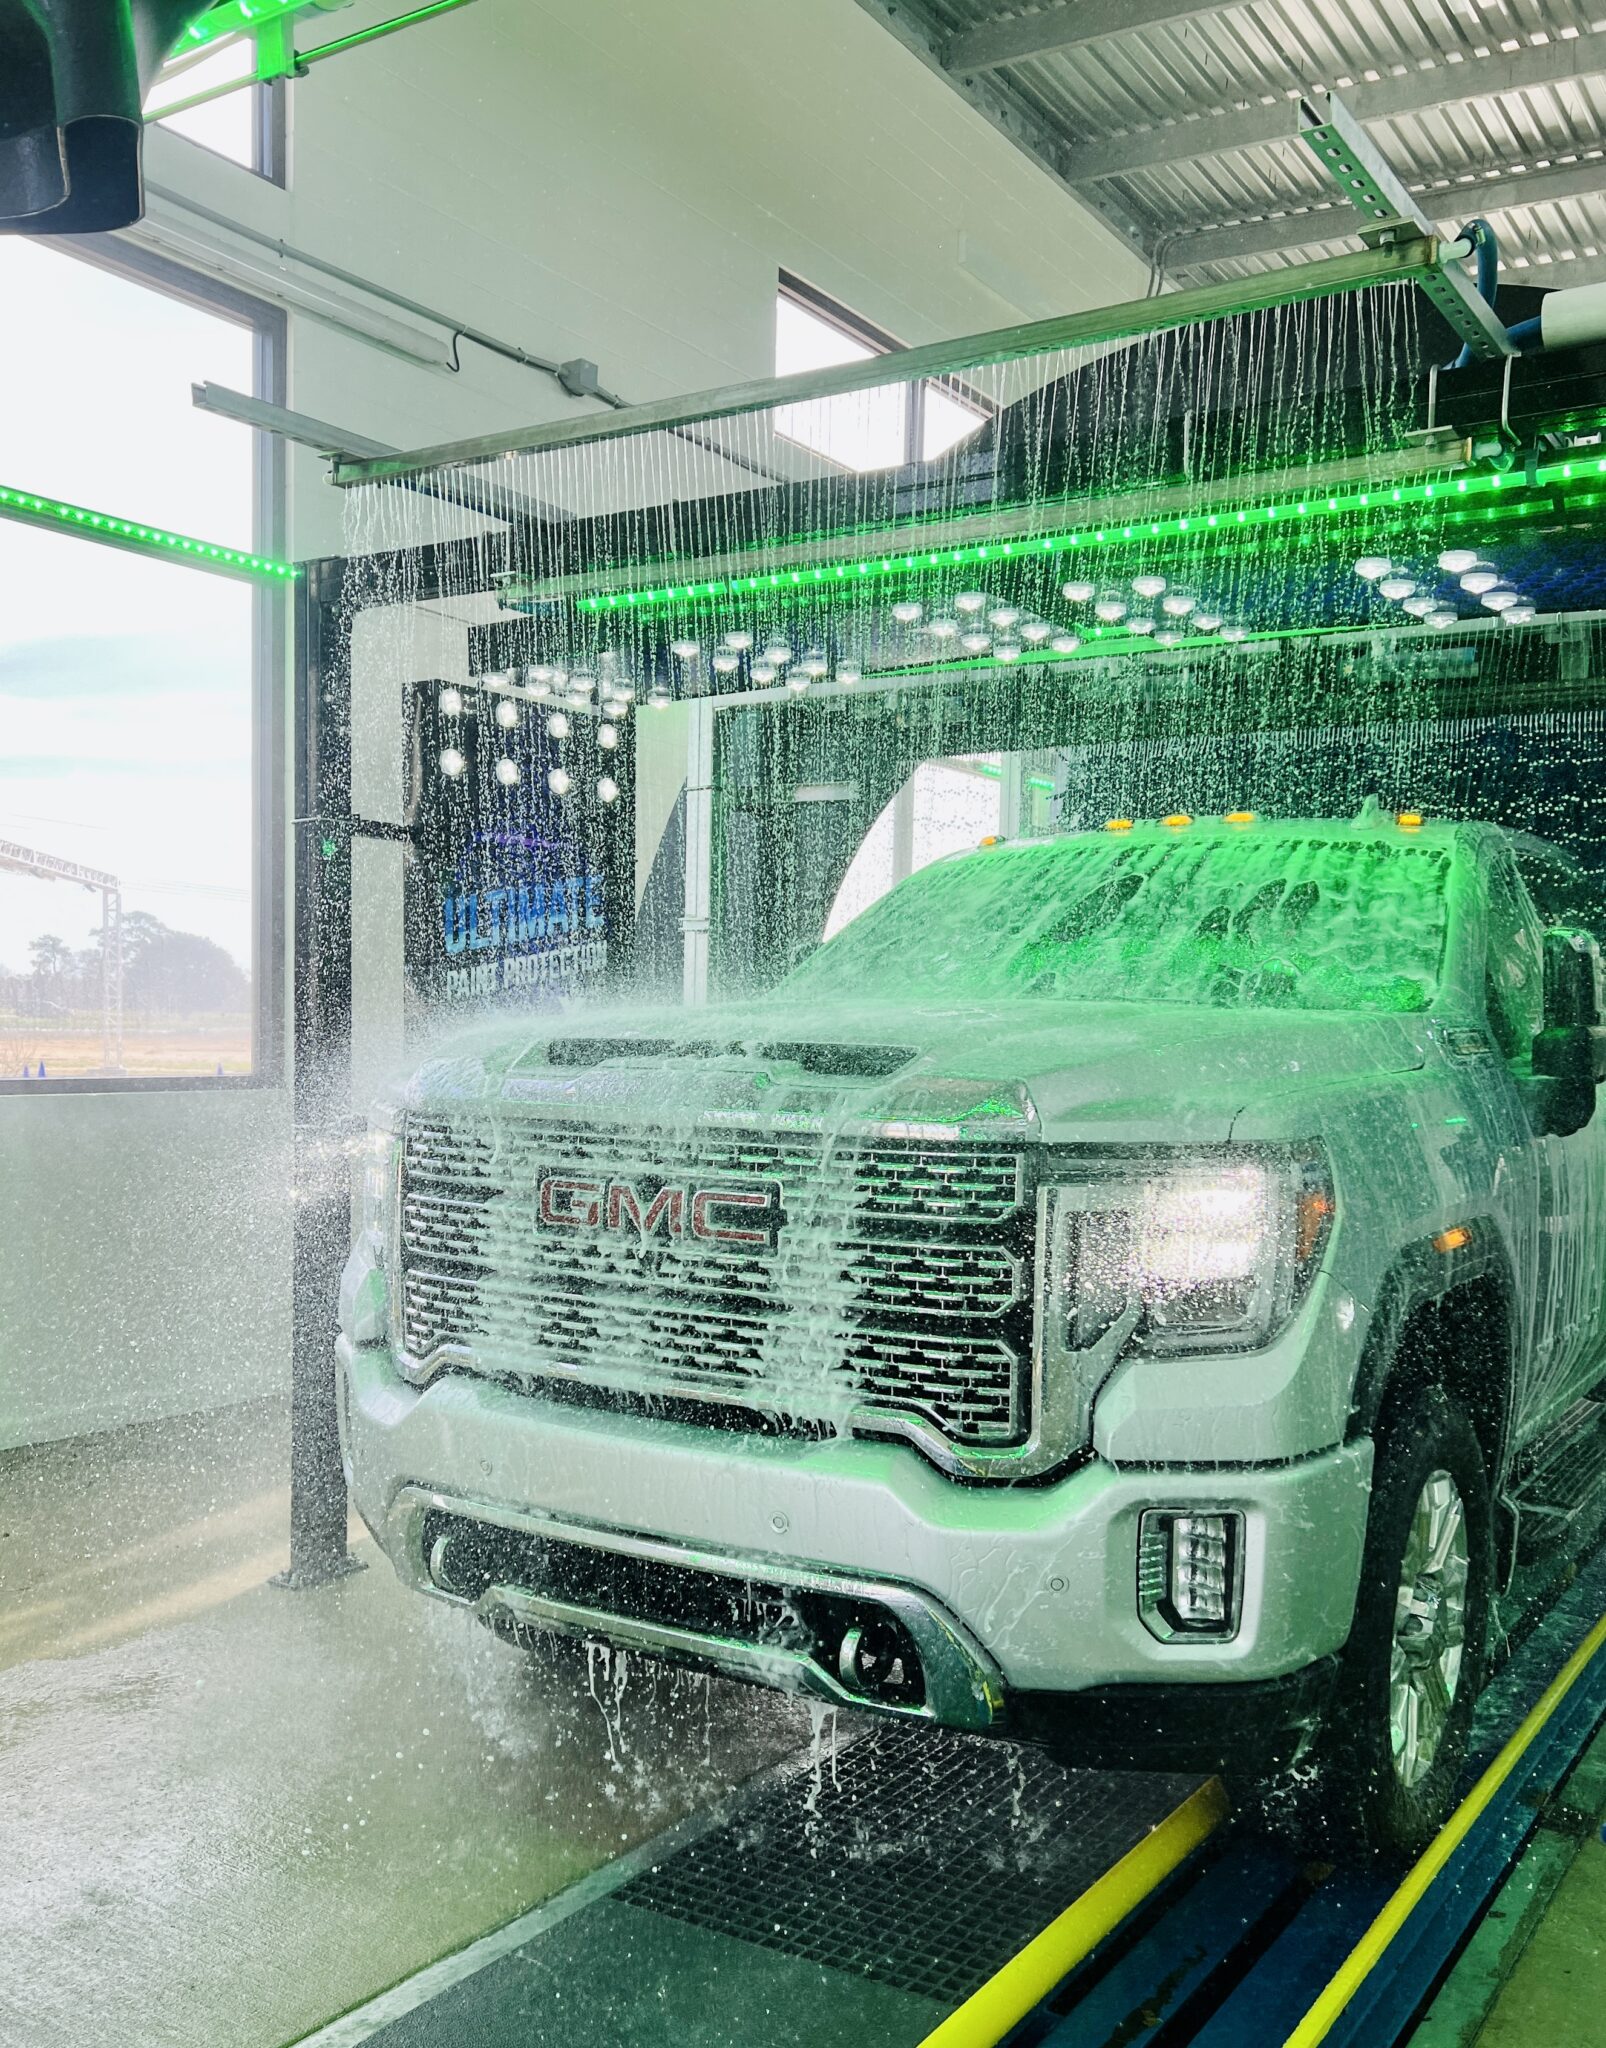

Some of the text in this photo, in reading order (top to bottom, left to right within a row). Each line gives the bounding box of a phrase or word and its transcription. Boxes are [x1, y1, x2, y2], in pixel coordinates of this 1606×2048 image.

[443, 874, 606, 956] ULTIMATE
[446, 939, 609, 999] PAINT PROTECTION
[539, 1176, 771, 1244] GMC
